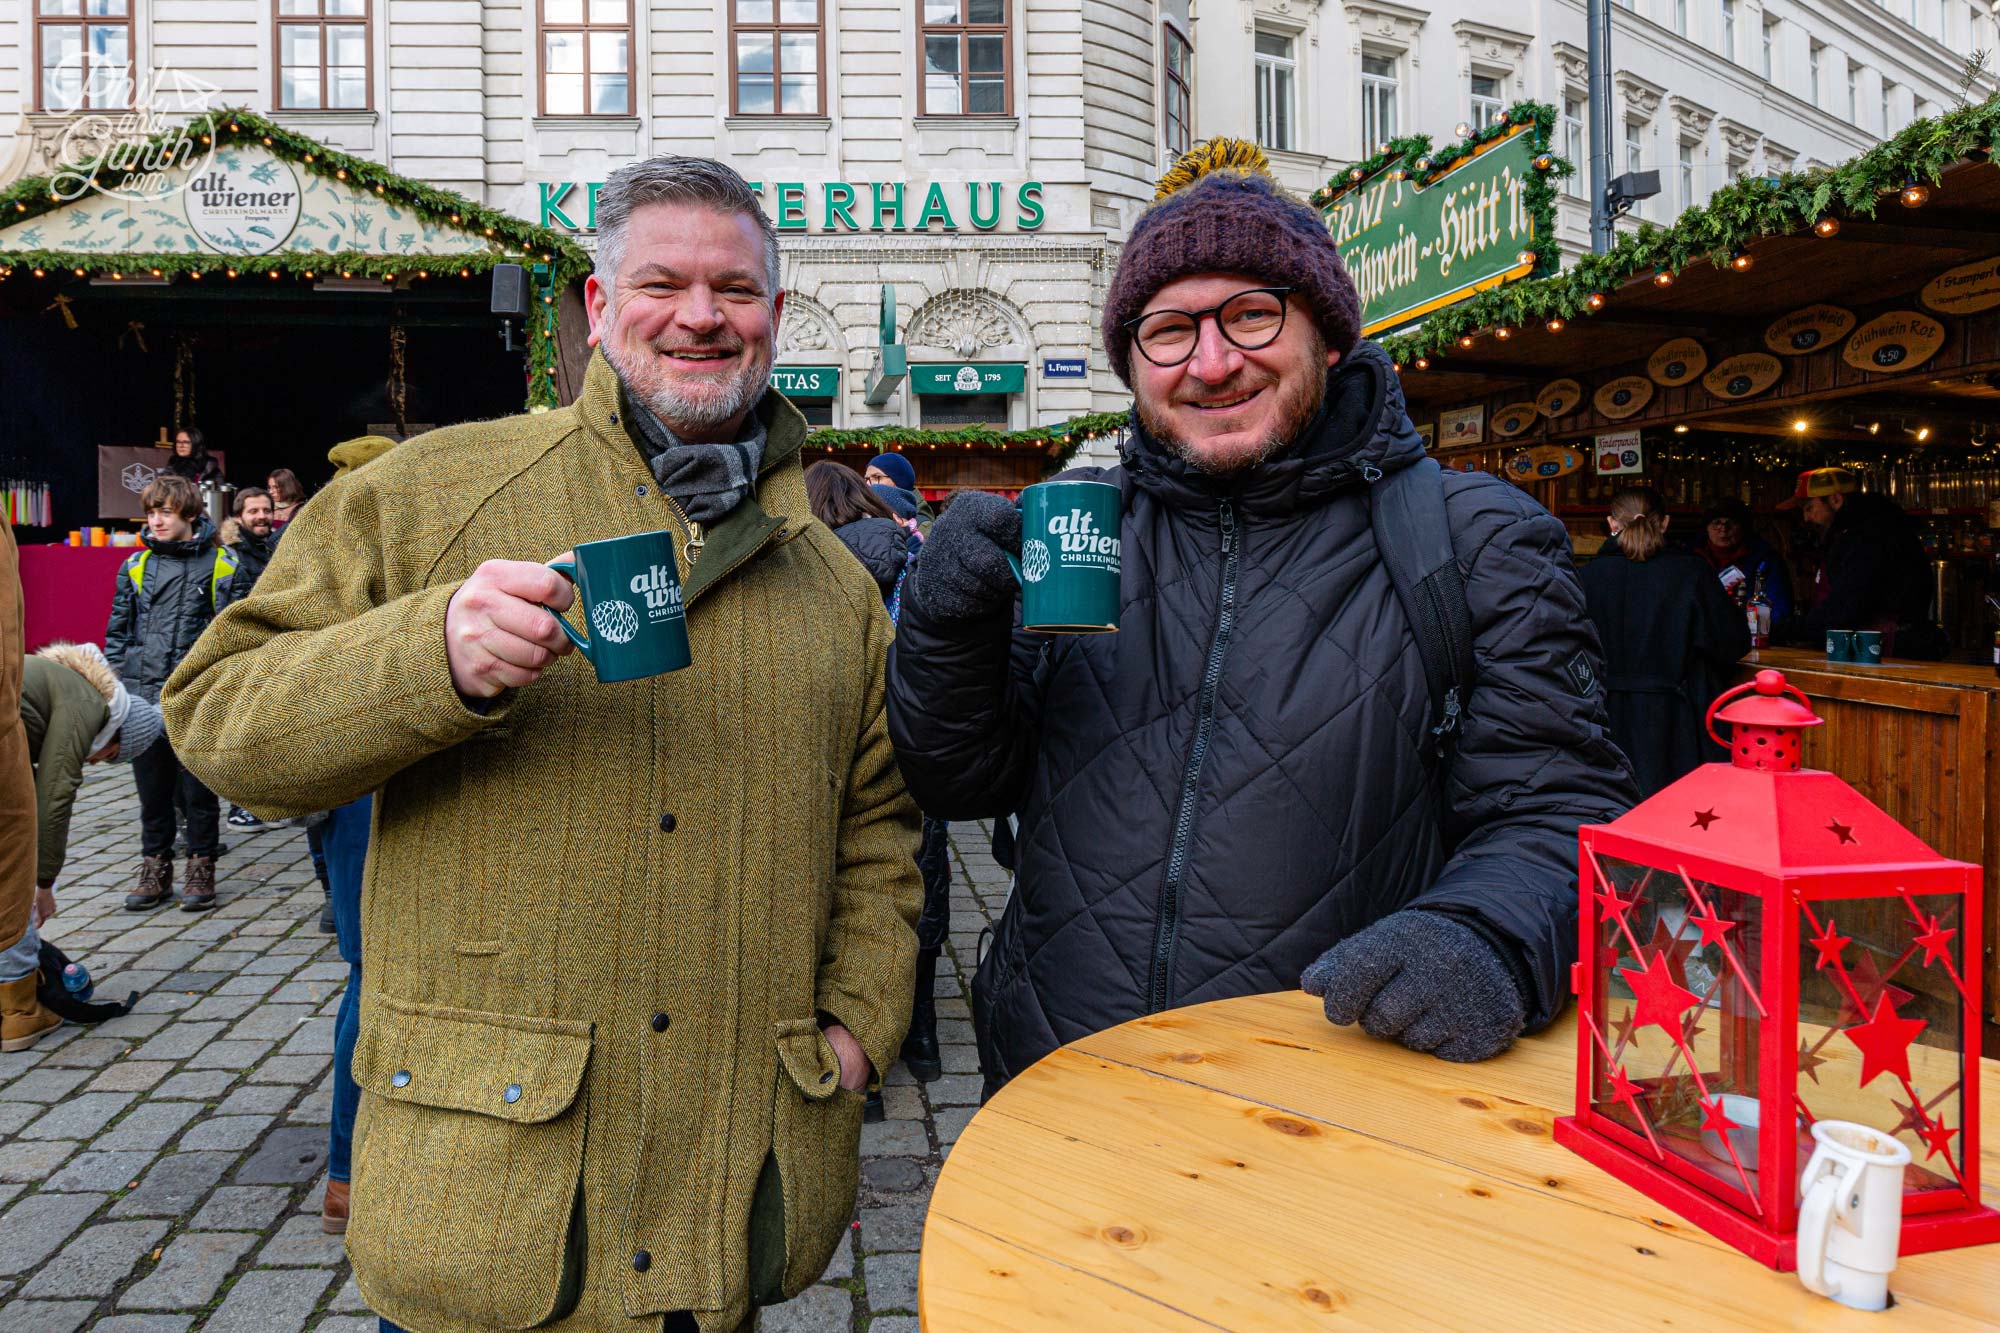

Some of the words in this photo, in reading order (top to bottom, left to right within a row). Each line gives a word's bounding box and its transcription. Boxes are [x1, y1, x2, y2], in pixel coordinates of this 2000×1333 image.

[191, 172, 235, 192] alt.
[202, 192, 295, 207] wiener
[1909, 319, 1937, 339] Rot
[934, 374, 952, 382] SEIT
[984, 373, 1002, 382] 1795
[1056, 363, 1082, 373] Freyung
[1048, 508, 1100, 535] alt.
[630, 564, 674, 594] alt.
